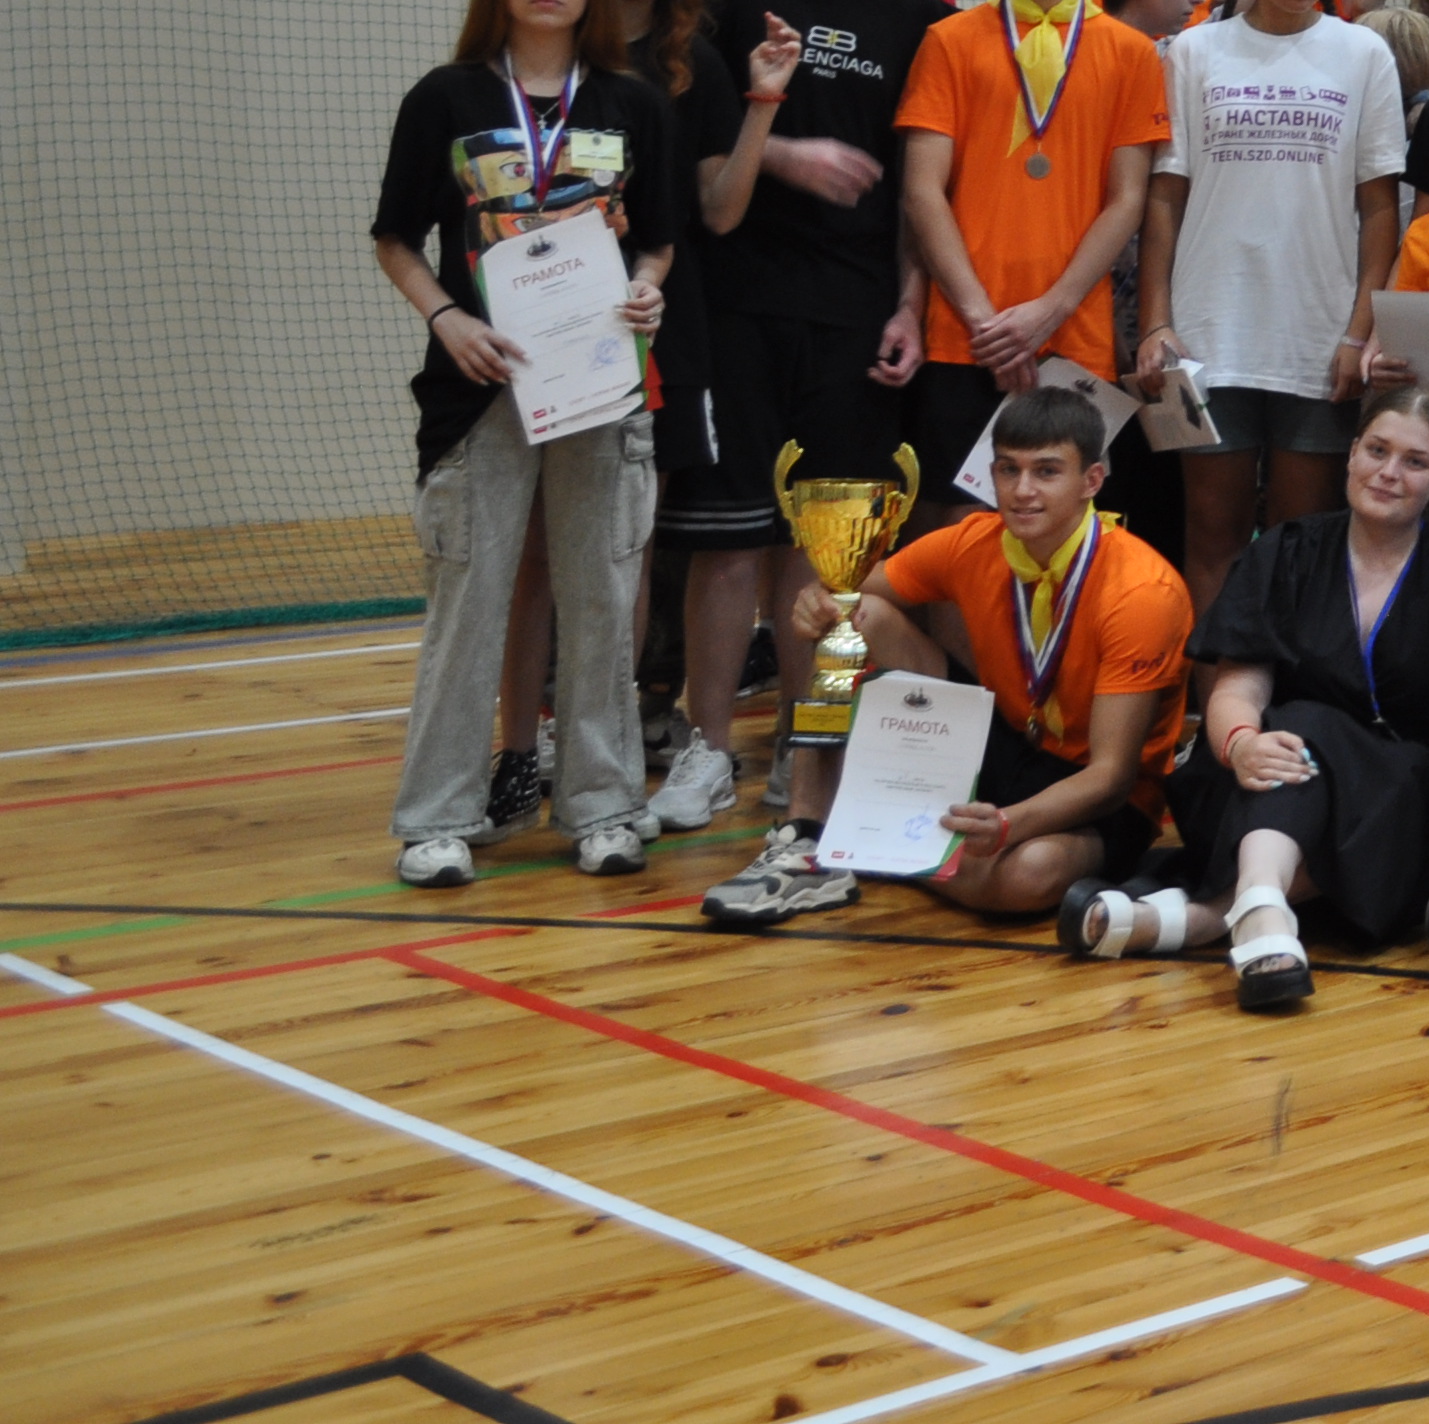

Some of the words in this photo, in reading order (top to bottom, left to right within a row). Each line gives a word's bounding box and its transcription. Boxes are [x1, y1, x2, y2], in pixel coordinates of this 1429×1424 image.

[798, 48, 884, 79] ENCIAGA
[1226, 109, 1343, 134] НАСТАВНИК
[1246, 129, 1307, 140] ЖЕЛЕЗНЫХ
[1211, 149, 1325, 165] TEEN.SZD.ONLINE
[512, 257, 585, 290] ГРАМОТА
[880, 717, 950, 736] ГРАМОТА
